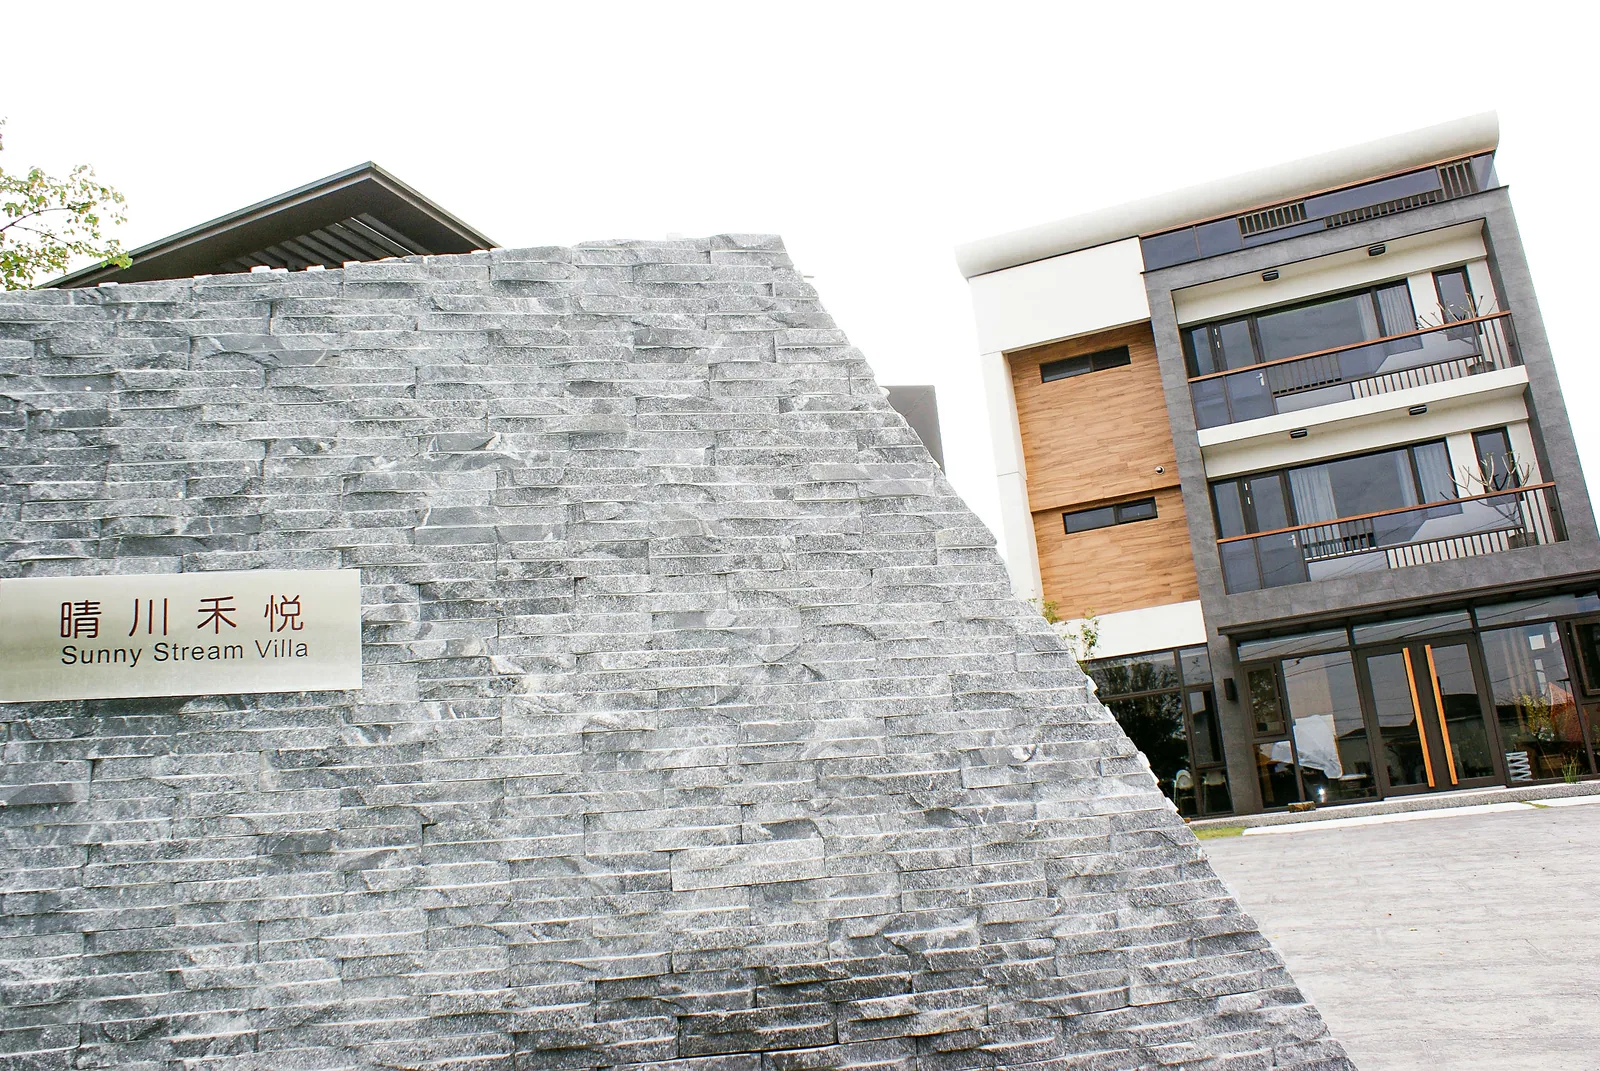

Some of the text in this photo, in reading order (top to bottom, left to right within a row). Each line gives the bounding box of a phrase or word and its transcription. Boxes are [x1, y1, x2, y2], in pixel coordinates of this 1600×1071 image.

[61, 638, 309, 668] Sunny Stream Villa
